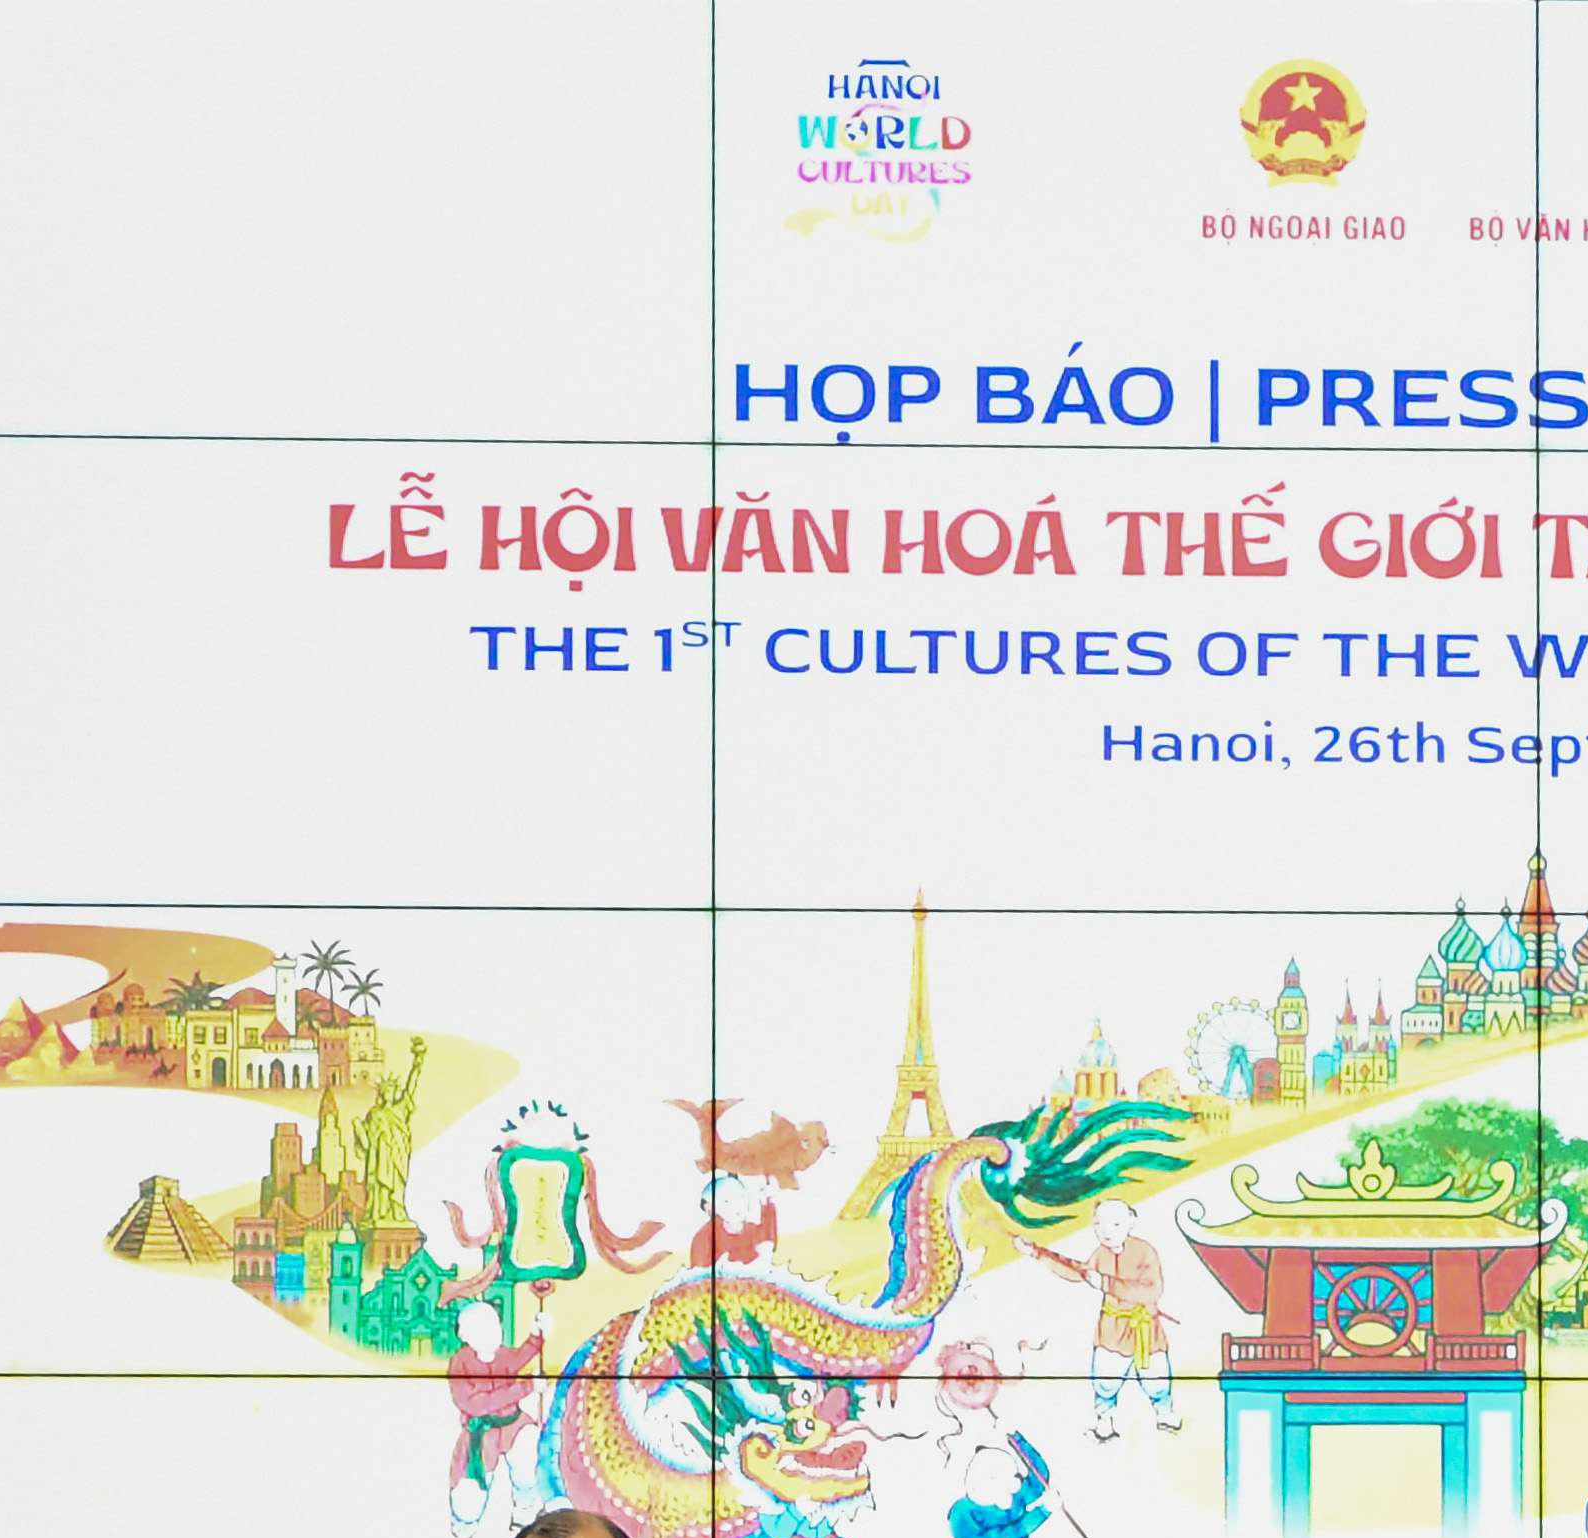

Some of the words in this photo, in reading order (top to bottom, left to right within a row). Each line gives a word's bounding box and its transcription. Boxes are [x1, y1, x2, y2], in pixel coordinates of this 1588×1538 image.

[797, 114, 972, 150] WORLD
[797, 160, 972, 184] CULTURES
[851, 192, 910, 216] DAY
[1344, 216, 1405, 240] GIAO
[736, 364, 941, 442] HỌP
[976, 341, 1174, 426] BÁO
[1258, 368, 1588, 429] PRESS
[330, 472, 447, 569] LỄ
[480, 488, 636, 591] HỘI
[661, 492, 849, 573] VĂN
[883, 494, 1076, 576] HOÁ
[1107, 482, 1287, 576] THẾ
[1319, 497, 1502, 579] GIỚI
[470, 626, 629, 671] THE
[766, 628, 1172, 676] CULTURES
[1198, 632, 1299, 676] OF
[1323, 633, 1480, 677] THE
[1104, 720, 1290, 769] Hanoi,
[1314, 721, 1444, 763] 26th
